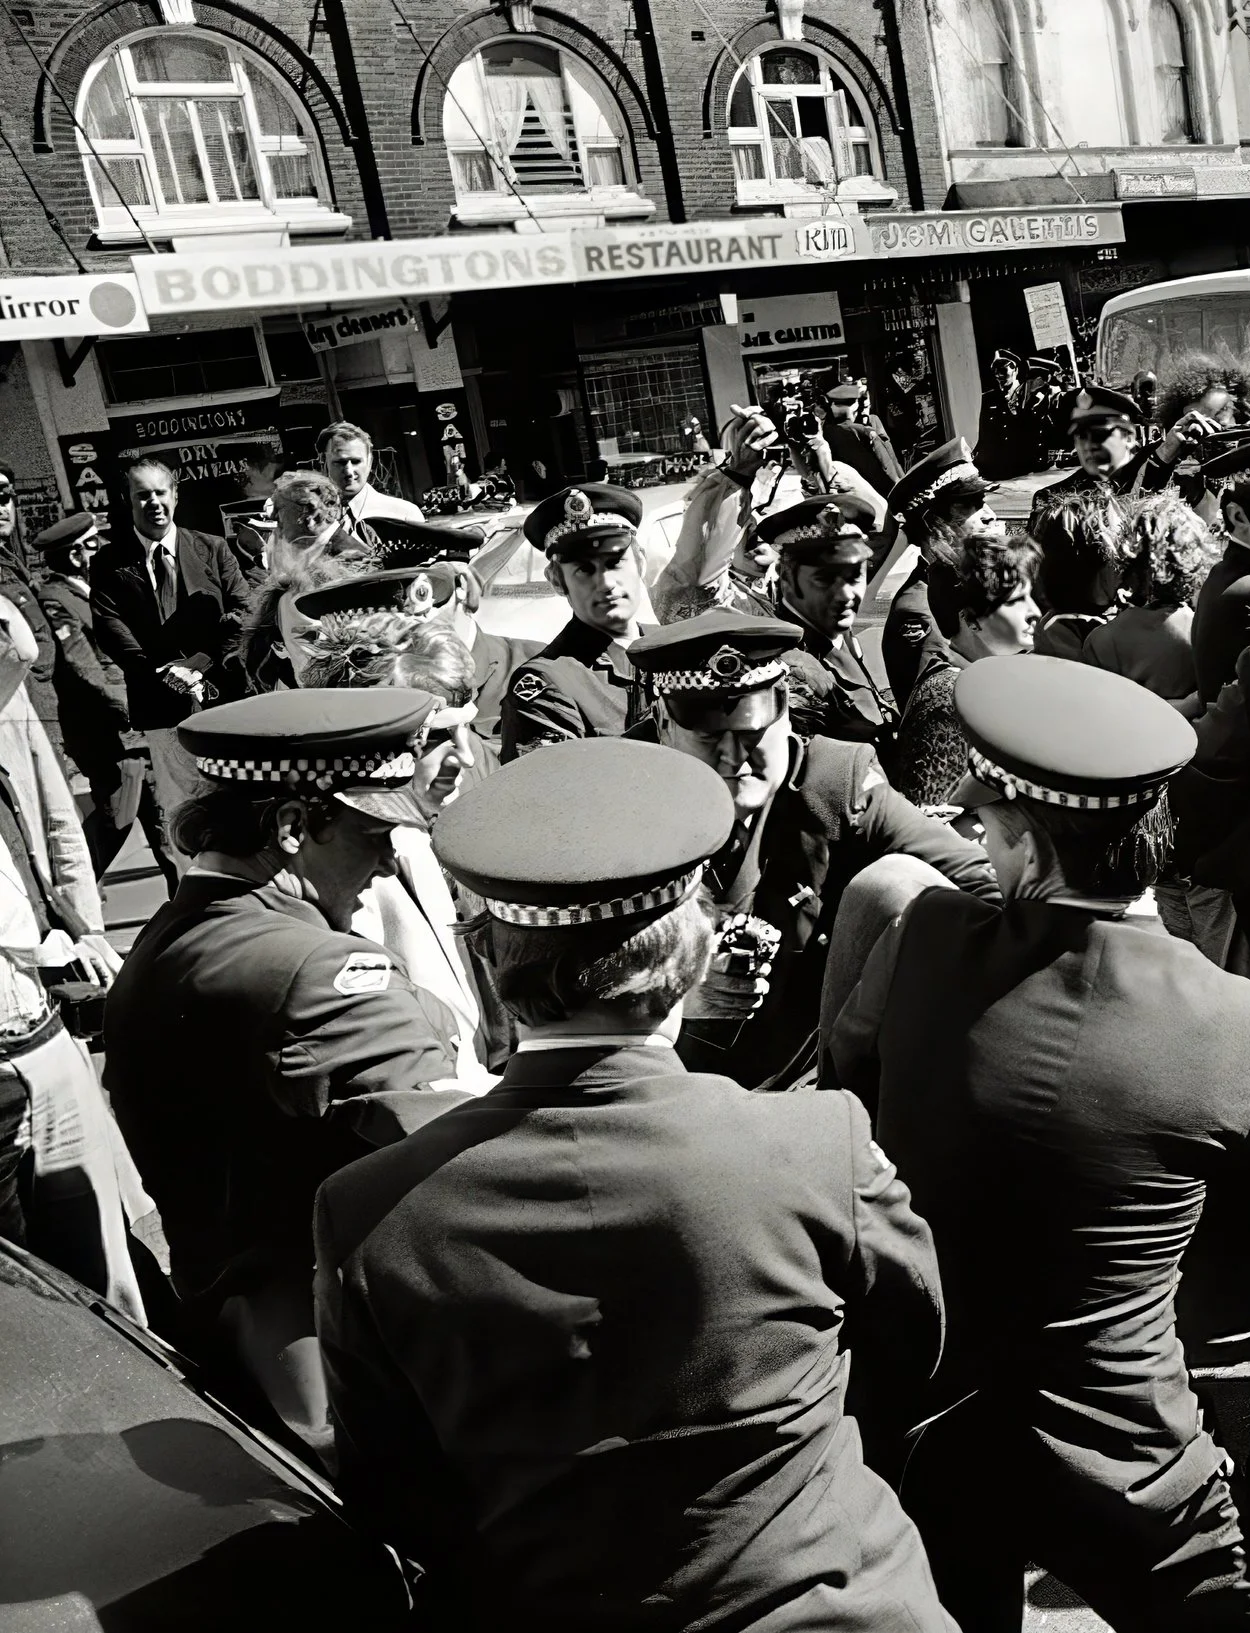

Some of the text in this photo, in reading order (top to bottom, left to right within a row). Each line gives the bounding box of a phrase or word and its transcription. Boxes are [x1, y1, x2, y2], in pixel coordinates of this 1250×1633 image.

[154, 234, 783, 306] BODDINGTONS RESTAURANT
[0, 295, 80, 319] irror
